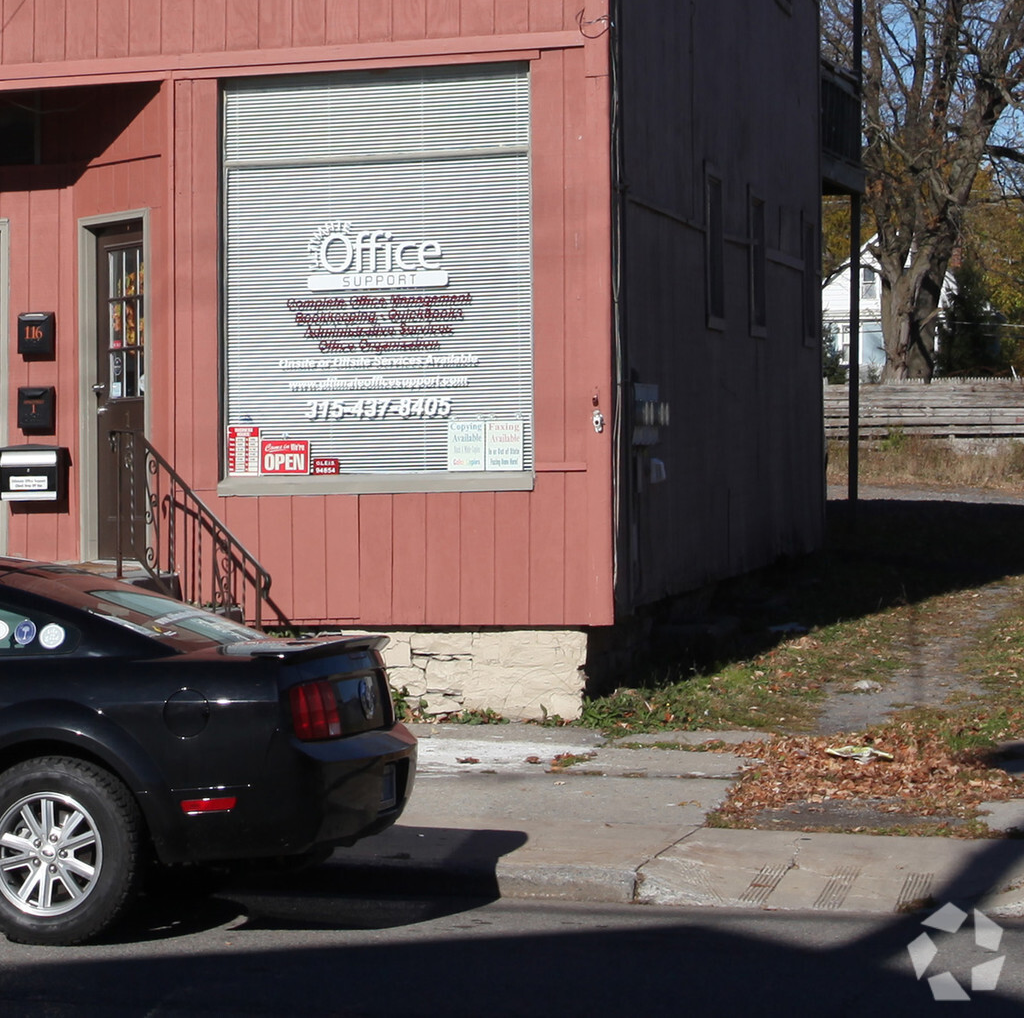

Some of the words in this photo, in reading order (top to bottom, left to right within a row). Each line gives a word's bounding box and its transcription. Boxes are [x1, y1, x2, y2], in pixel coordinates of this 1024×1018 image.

[320, 231, 443, 274] Office
[342, 274, 417, 287] SUPPORT
[350, 294, 387, 308] Office
[390, 292, 472, 307] Management
[24, 325, 43, 340] 116
[305, 398, 452, 420] 315-437-8405
[450, 423, 483, 432] Copying
[488, 423, 520, 431] Faxing
[452, 434, 482, 442] Available
[491, 434, 520, 443] Available
[264, 453, 305, 471] OPEN
